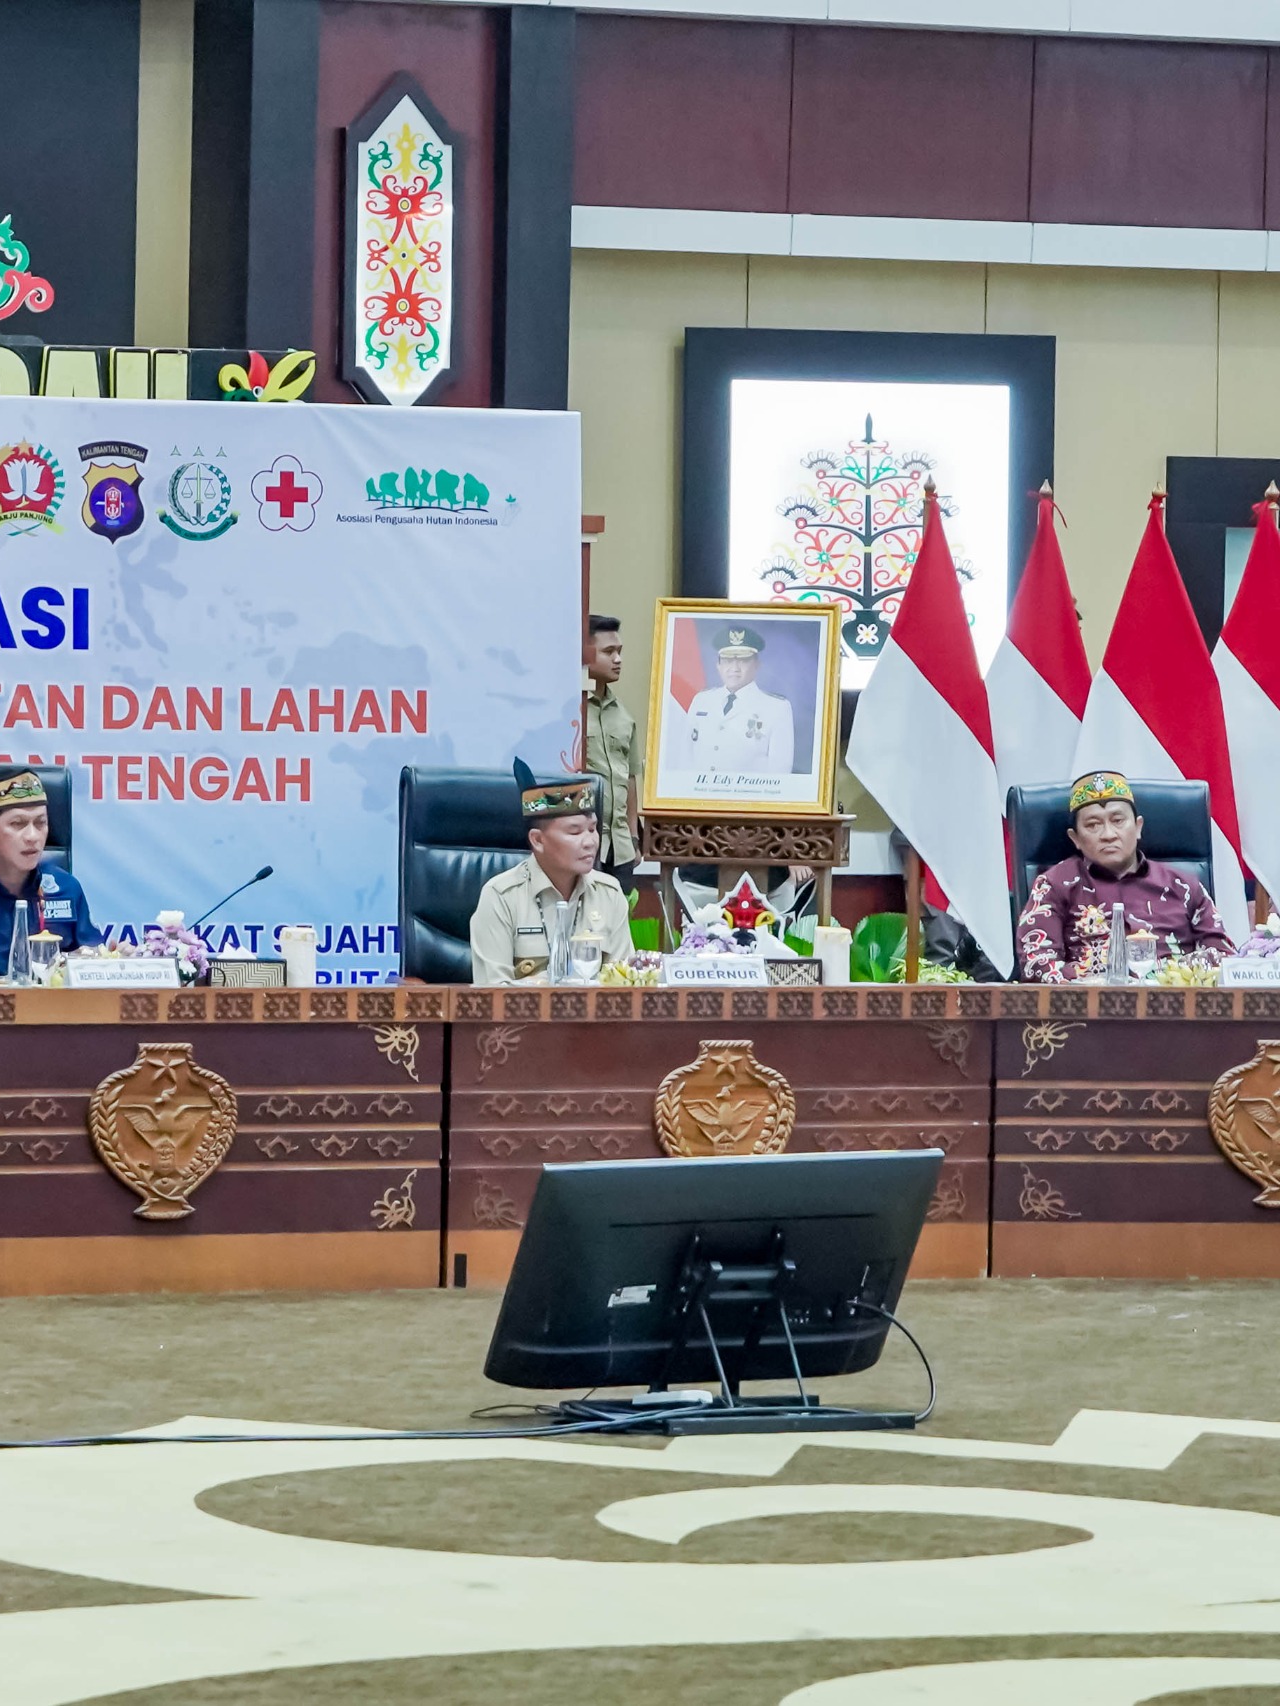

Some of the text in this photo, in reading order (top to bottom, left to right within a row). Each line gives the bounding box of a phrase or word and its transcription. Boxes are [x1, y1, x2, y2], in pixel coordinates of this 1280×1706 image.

[81, 445, 145, 459] KALIMANTAN TENGAH
[336, 513, 498, 526] Asosiasi Pengusaha Hutan Indonesia
[103, 686, 222, 731] DAN
[241, 689, 427, 734] LAHAN
[82, 756, 311, 802] TENGAH
[713, 774, 734, 787] Edy
[736, 775, 781, 786] Pratowo
[674, 969, 759, 980] GUBERNUR
[1231, 970, 1264, 980] WAKIL
